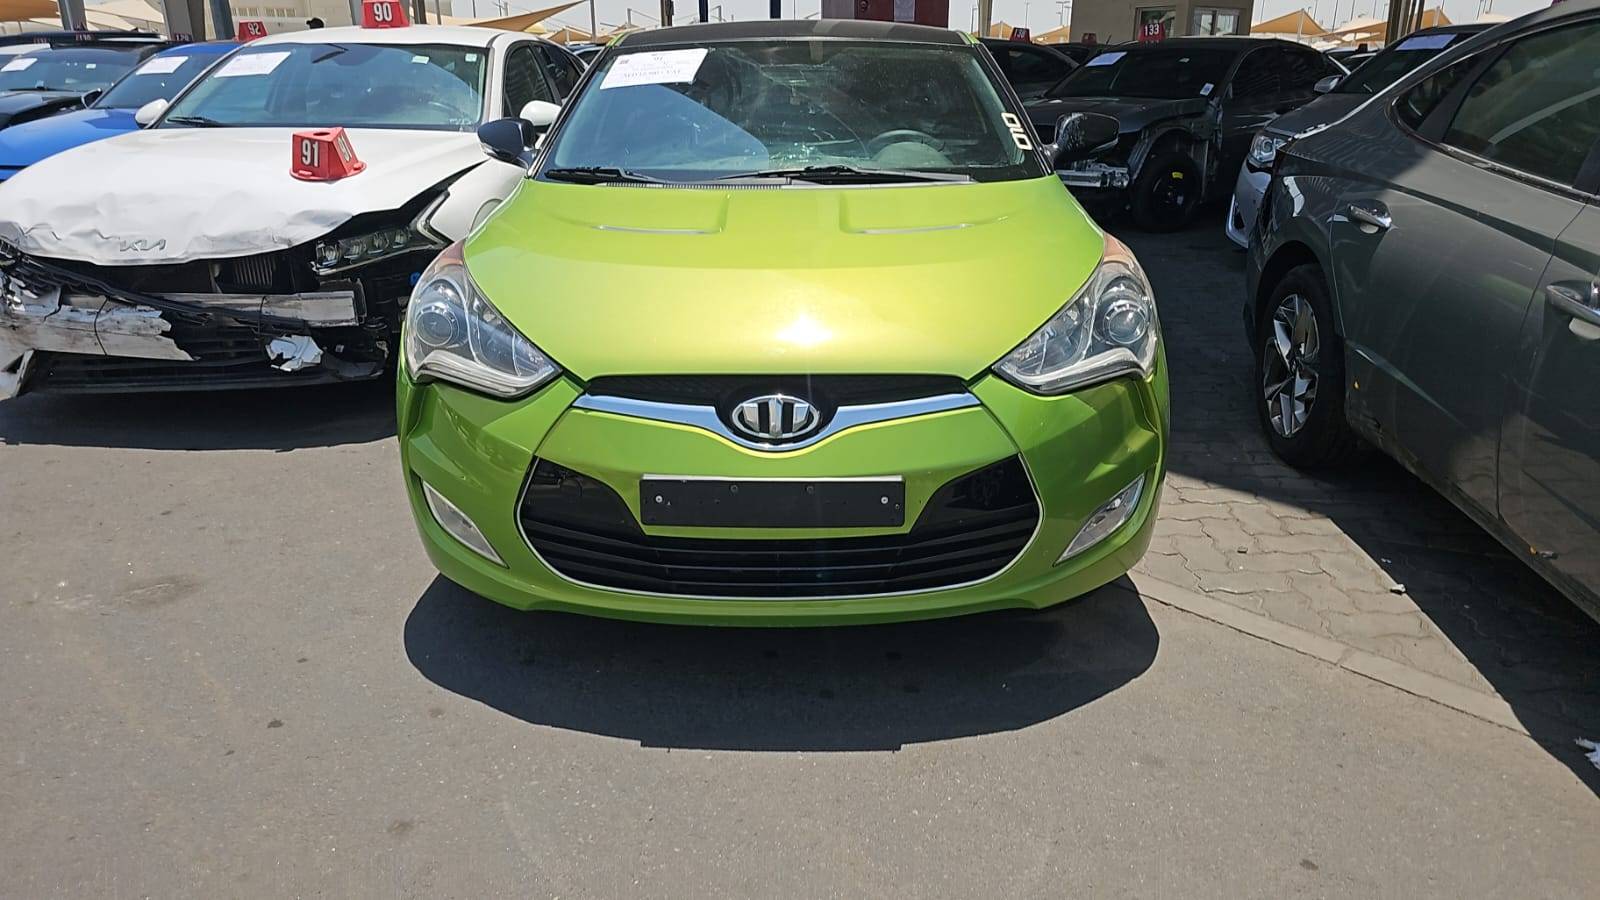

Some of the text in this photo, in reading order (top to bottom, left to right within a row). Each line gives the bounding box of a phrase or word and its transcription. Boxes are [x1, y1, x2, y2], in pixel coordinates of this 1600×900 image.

[372, 3, 393, 23] 90
[247, 22, 262, 35] 92
[1144, 23, 1160, 36] 133
[302, 138, 319, 167] 91
